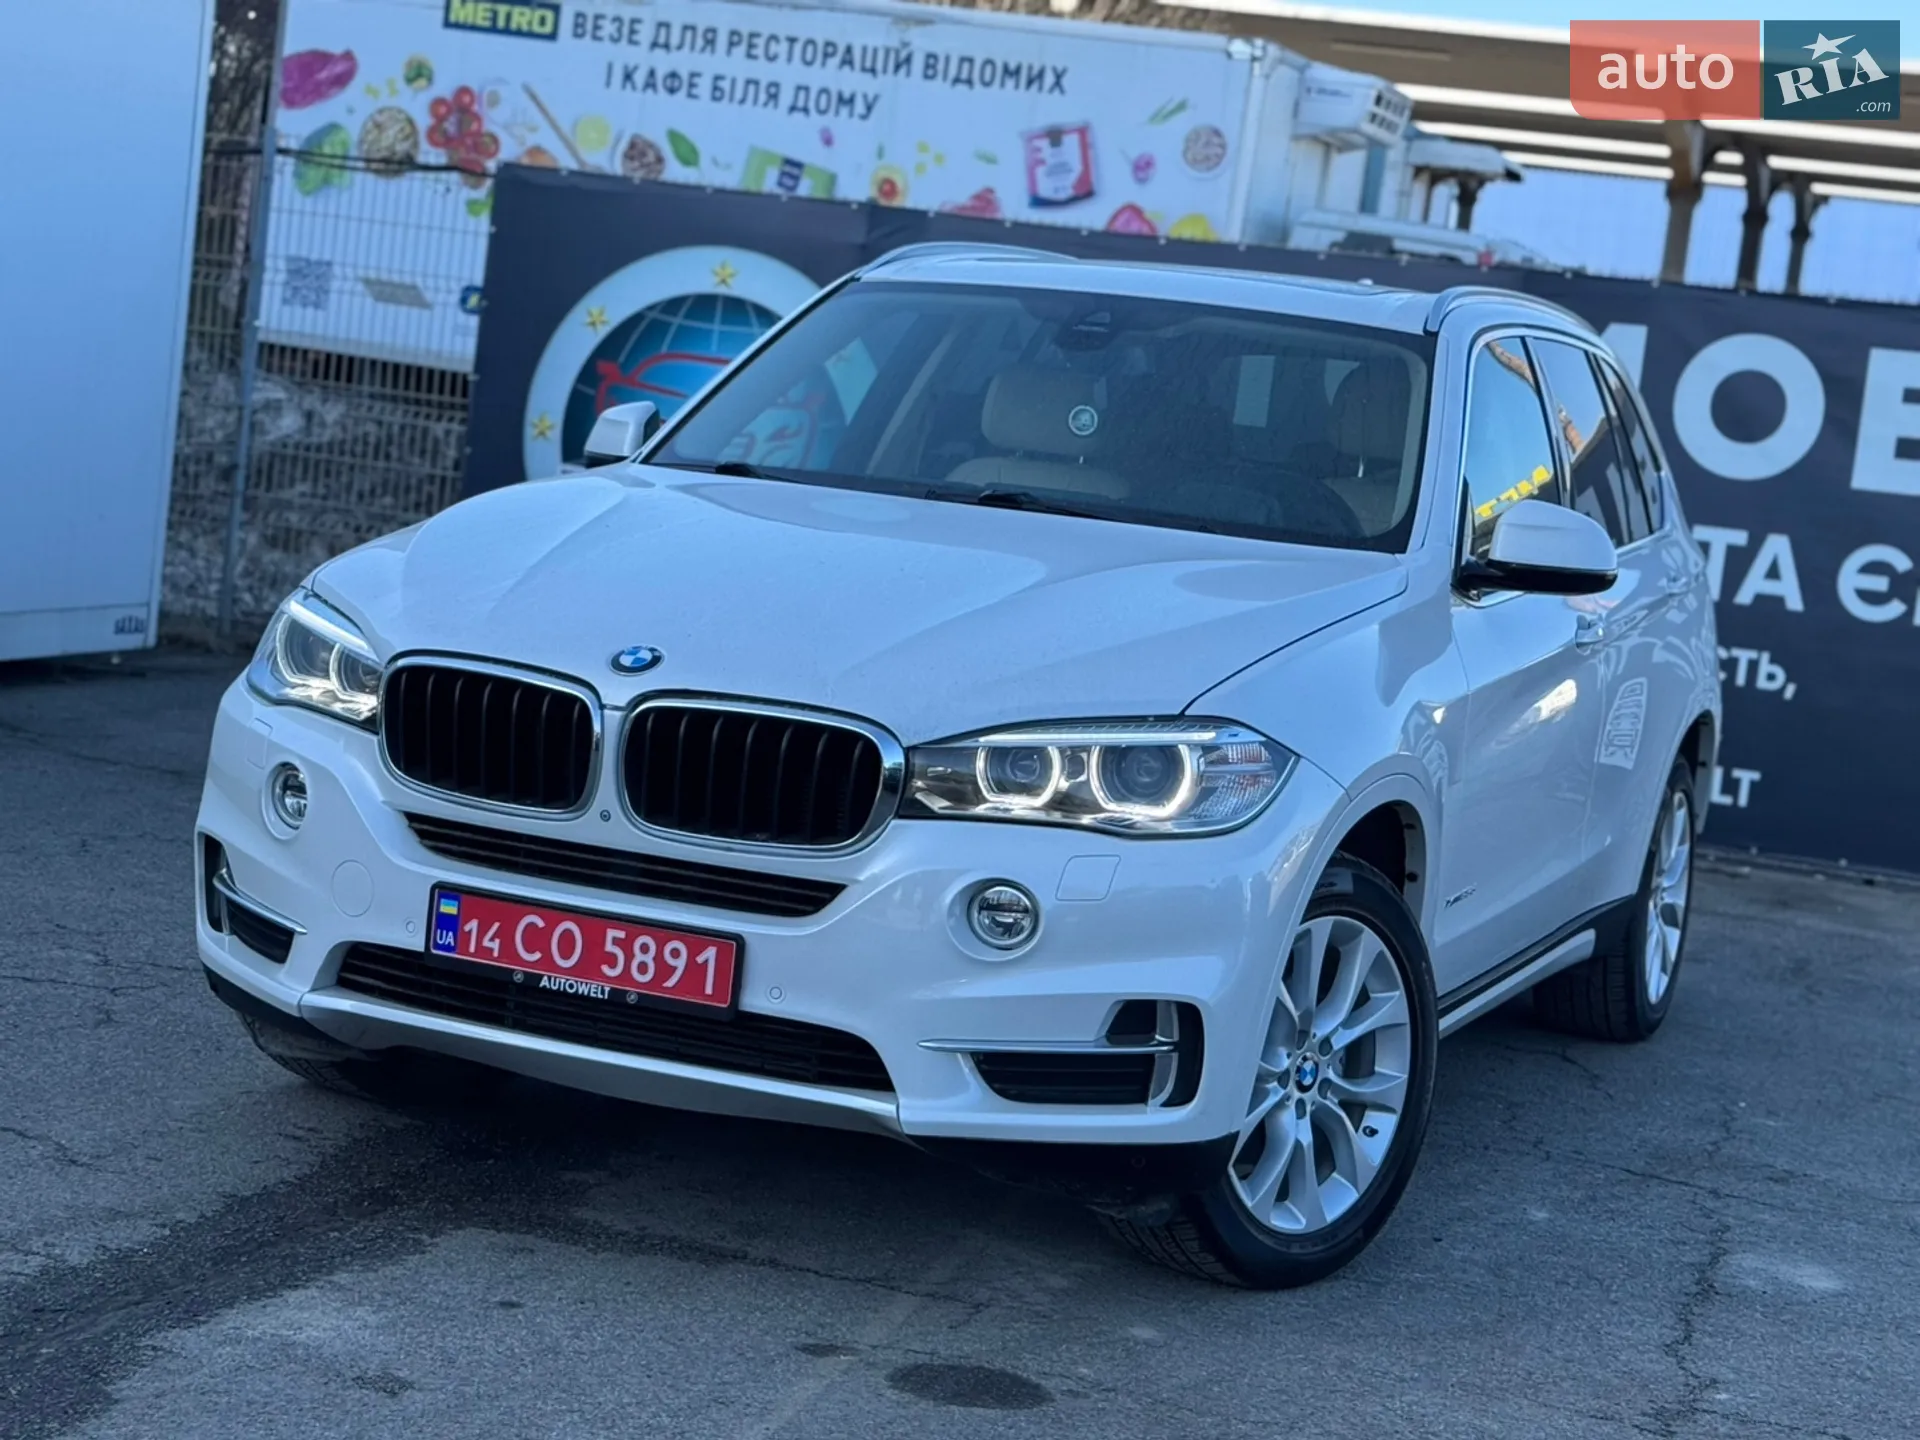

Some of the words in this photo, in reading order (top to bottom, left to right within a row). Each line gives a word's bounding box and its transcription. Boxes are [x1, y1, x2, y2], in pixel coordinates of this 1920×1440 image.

[447, 0, 556, 35] METRO
[572, 11, 643, 46] ВЕЗЕ
[650, 21, 718, 55] ДЛЯ
[727, 30, 914, 79] РЕСТОРАЦІЙ
[922, 52, 1069, 96] ВІДОМИХ
[621, 64, 703, 100] КАФЕ
[711, 74, 781, 110] БІЛЯ
[788, 84, 881, 121] ДОМУ
[1692, 525, 1805, 612] ТА
[1836, 543, 1920, 627] Є
[436, 928, 455, 947] UA
[463, 918, 501, 957] 14
[515, 914, 583, 968] CO
[600, 928, 719, 995] 5891
[539, 975, 611, 999] AUTOWELT
